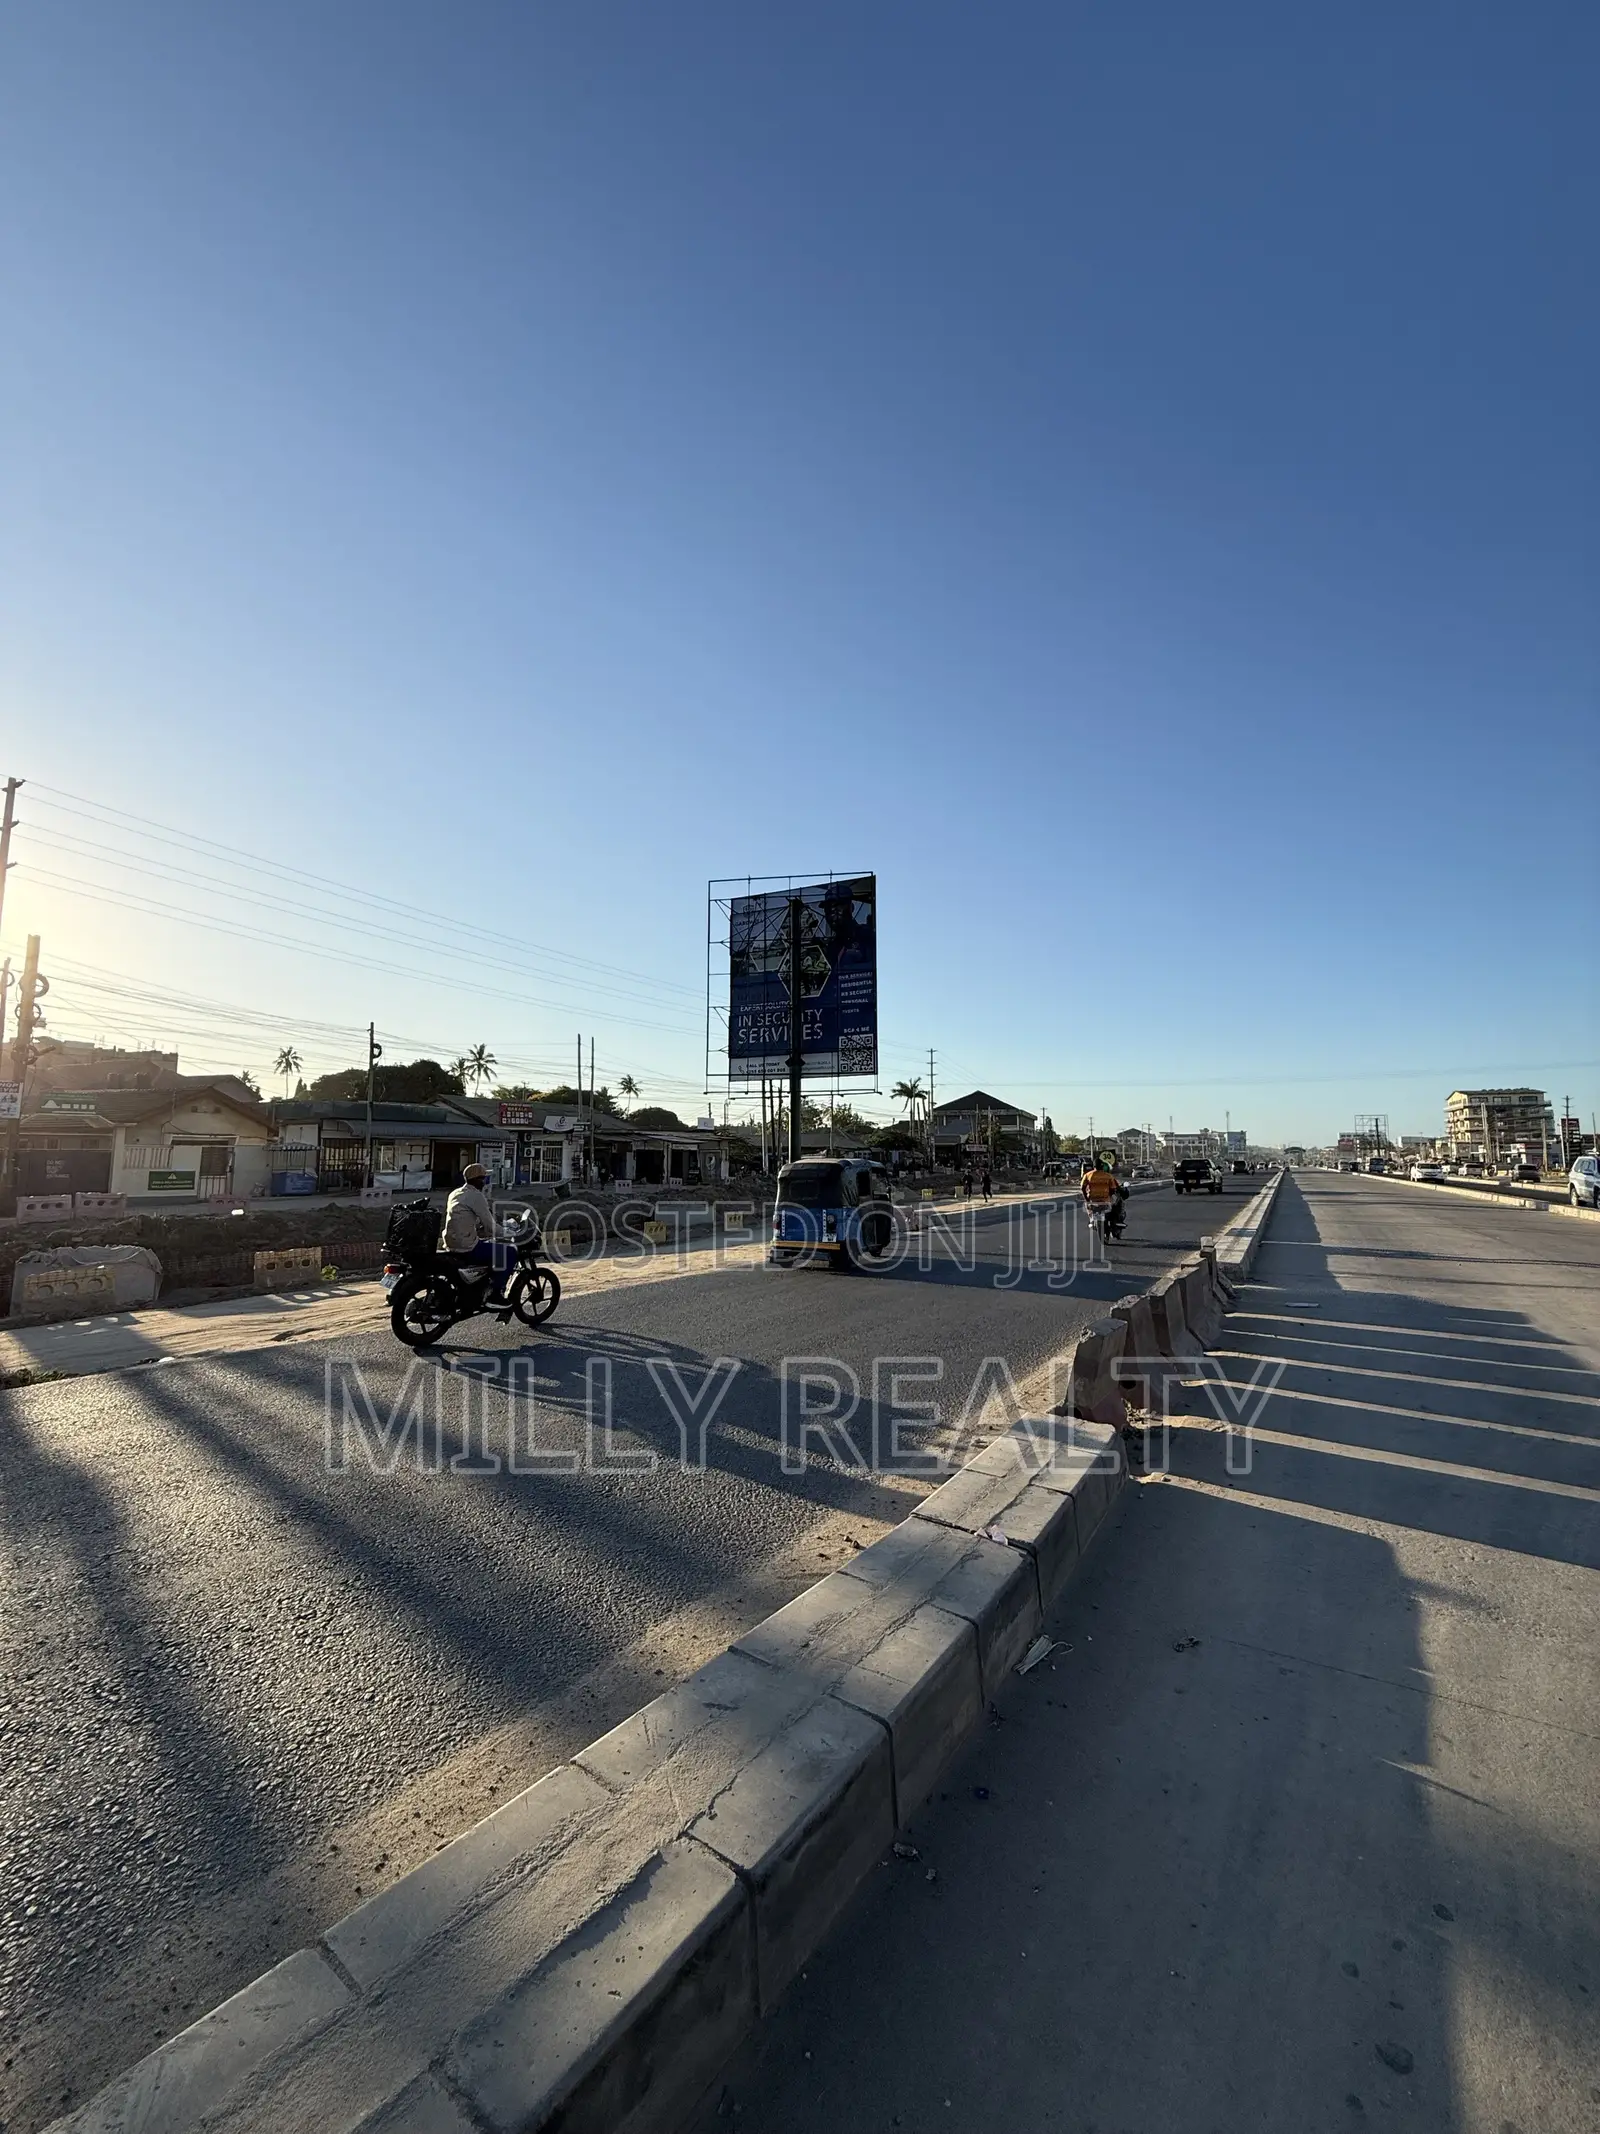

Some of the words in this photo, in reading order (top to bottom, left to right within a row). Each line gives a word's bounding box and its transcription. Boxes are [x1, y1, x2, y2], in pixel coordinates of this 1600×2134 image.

[850, 988, 873, 996] SECURIT
[738, 1014, 752, 1027] IN
[757, 1008, 823, 1026] SECUITY
[738, 1023, 823, 1044] SERVIES
